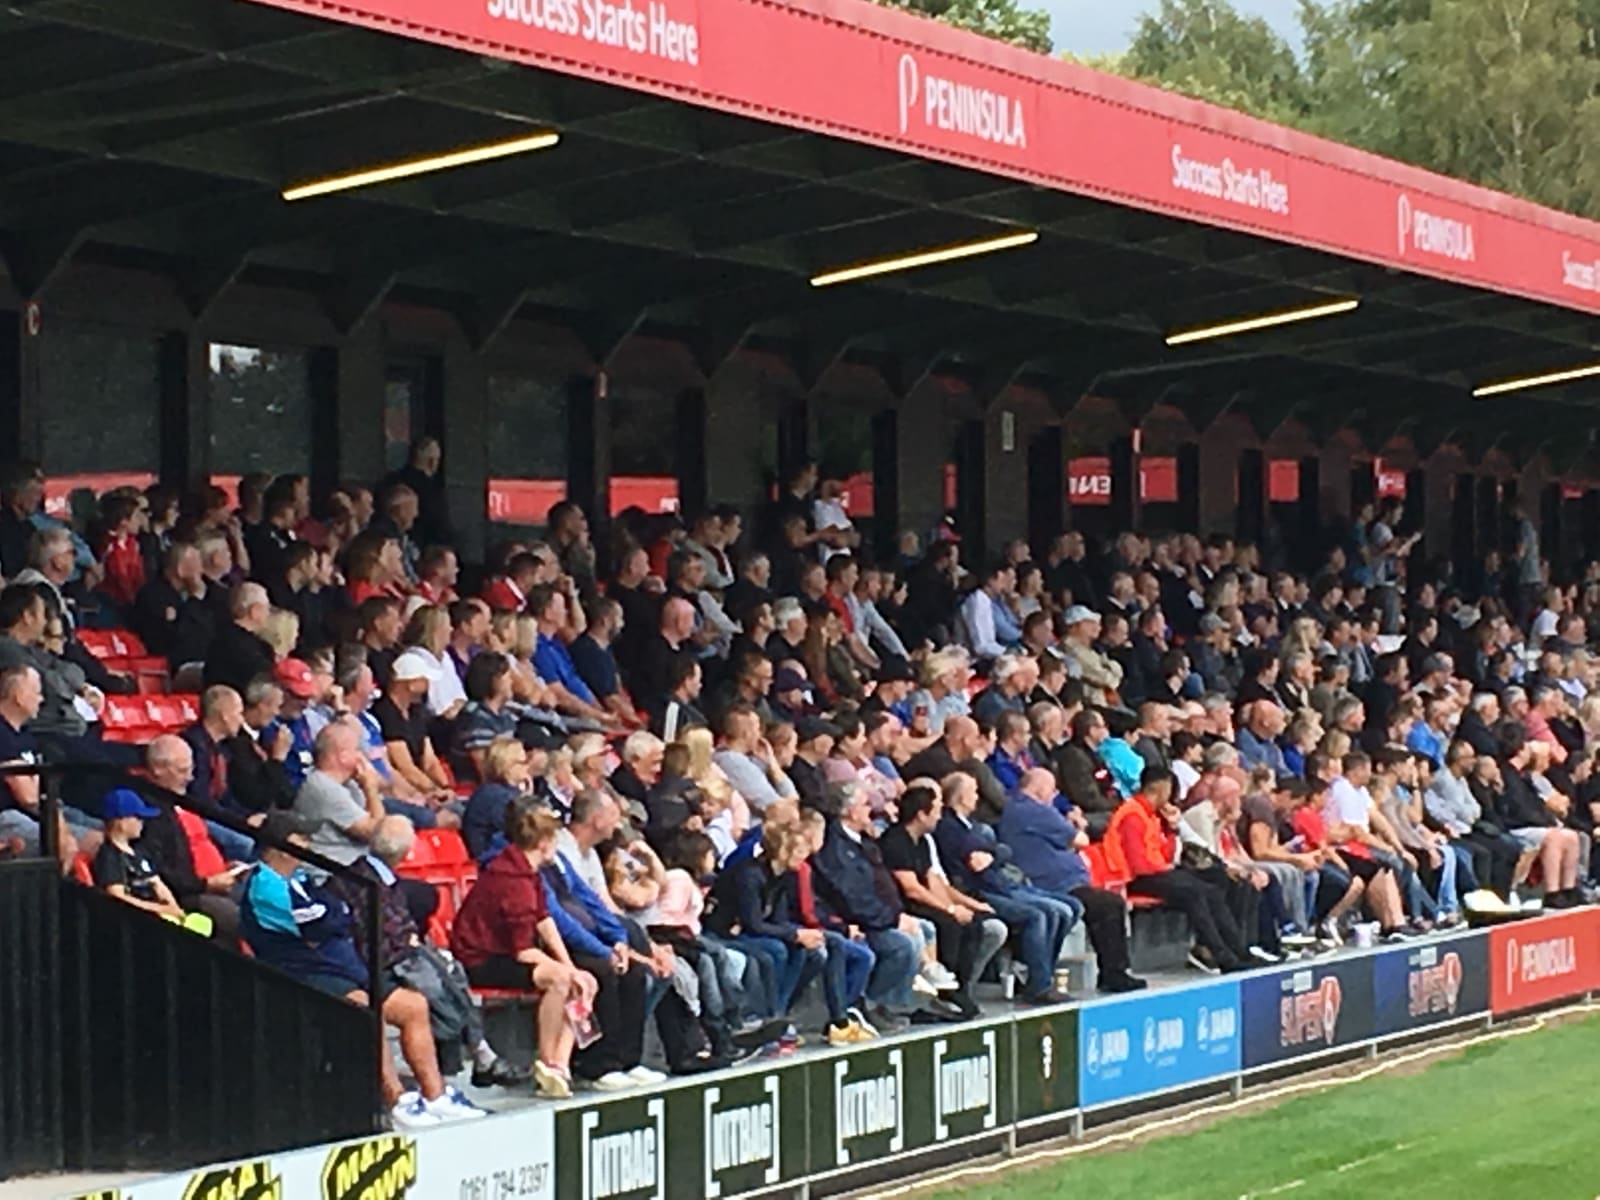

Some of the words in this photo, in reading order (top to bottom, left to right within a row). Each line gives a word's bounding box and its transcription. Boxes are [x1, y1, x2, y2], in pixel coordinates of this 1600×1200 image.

[581, 0, 648, 53] Starts
[649, 2, 699, 66] Here
[925, 75, 1027, 149] PENINSULA
[1171, 143, 1222, 199] Success
[1221, 157, 1261, 208] Starts
[1259, 168, 1290, 215] Here
[1413, 209, 1476, 262] PENINSULA
[1521, 935, 1577, 982] PENINSULA
